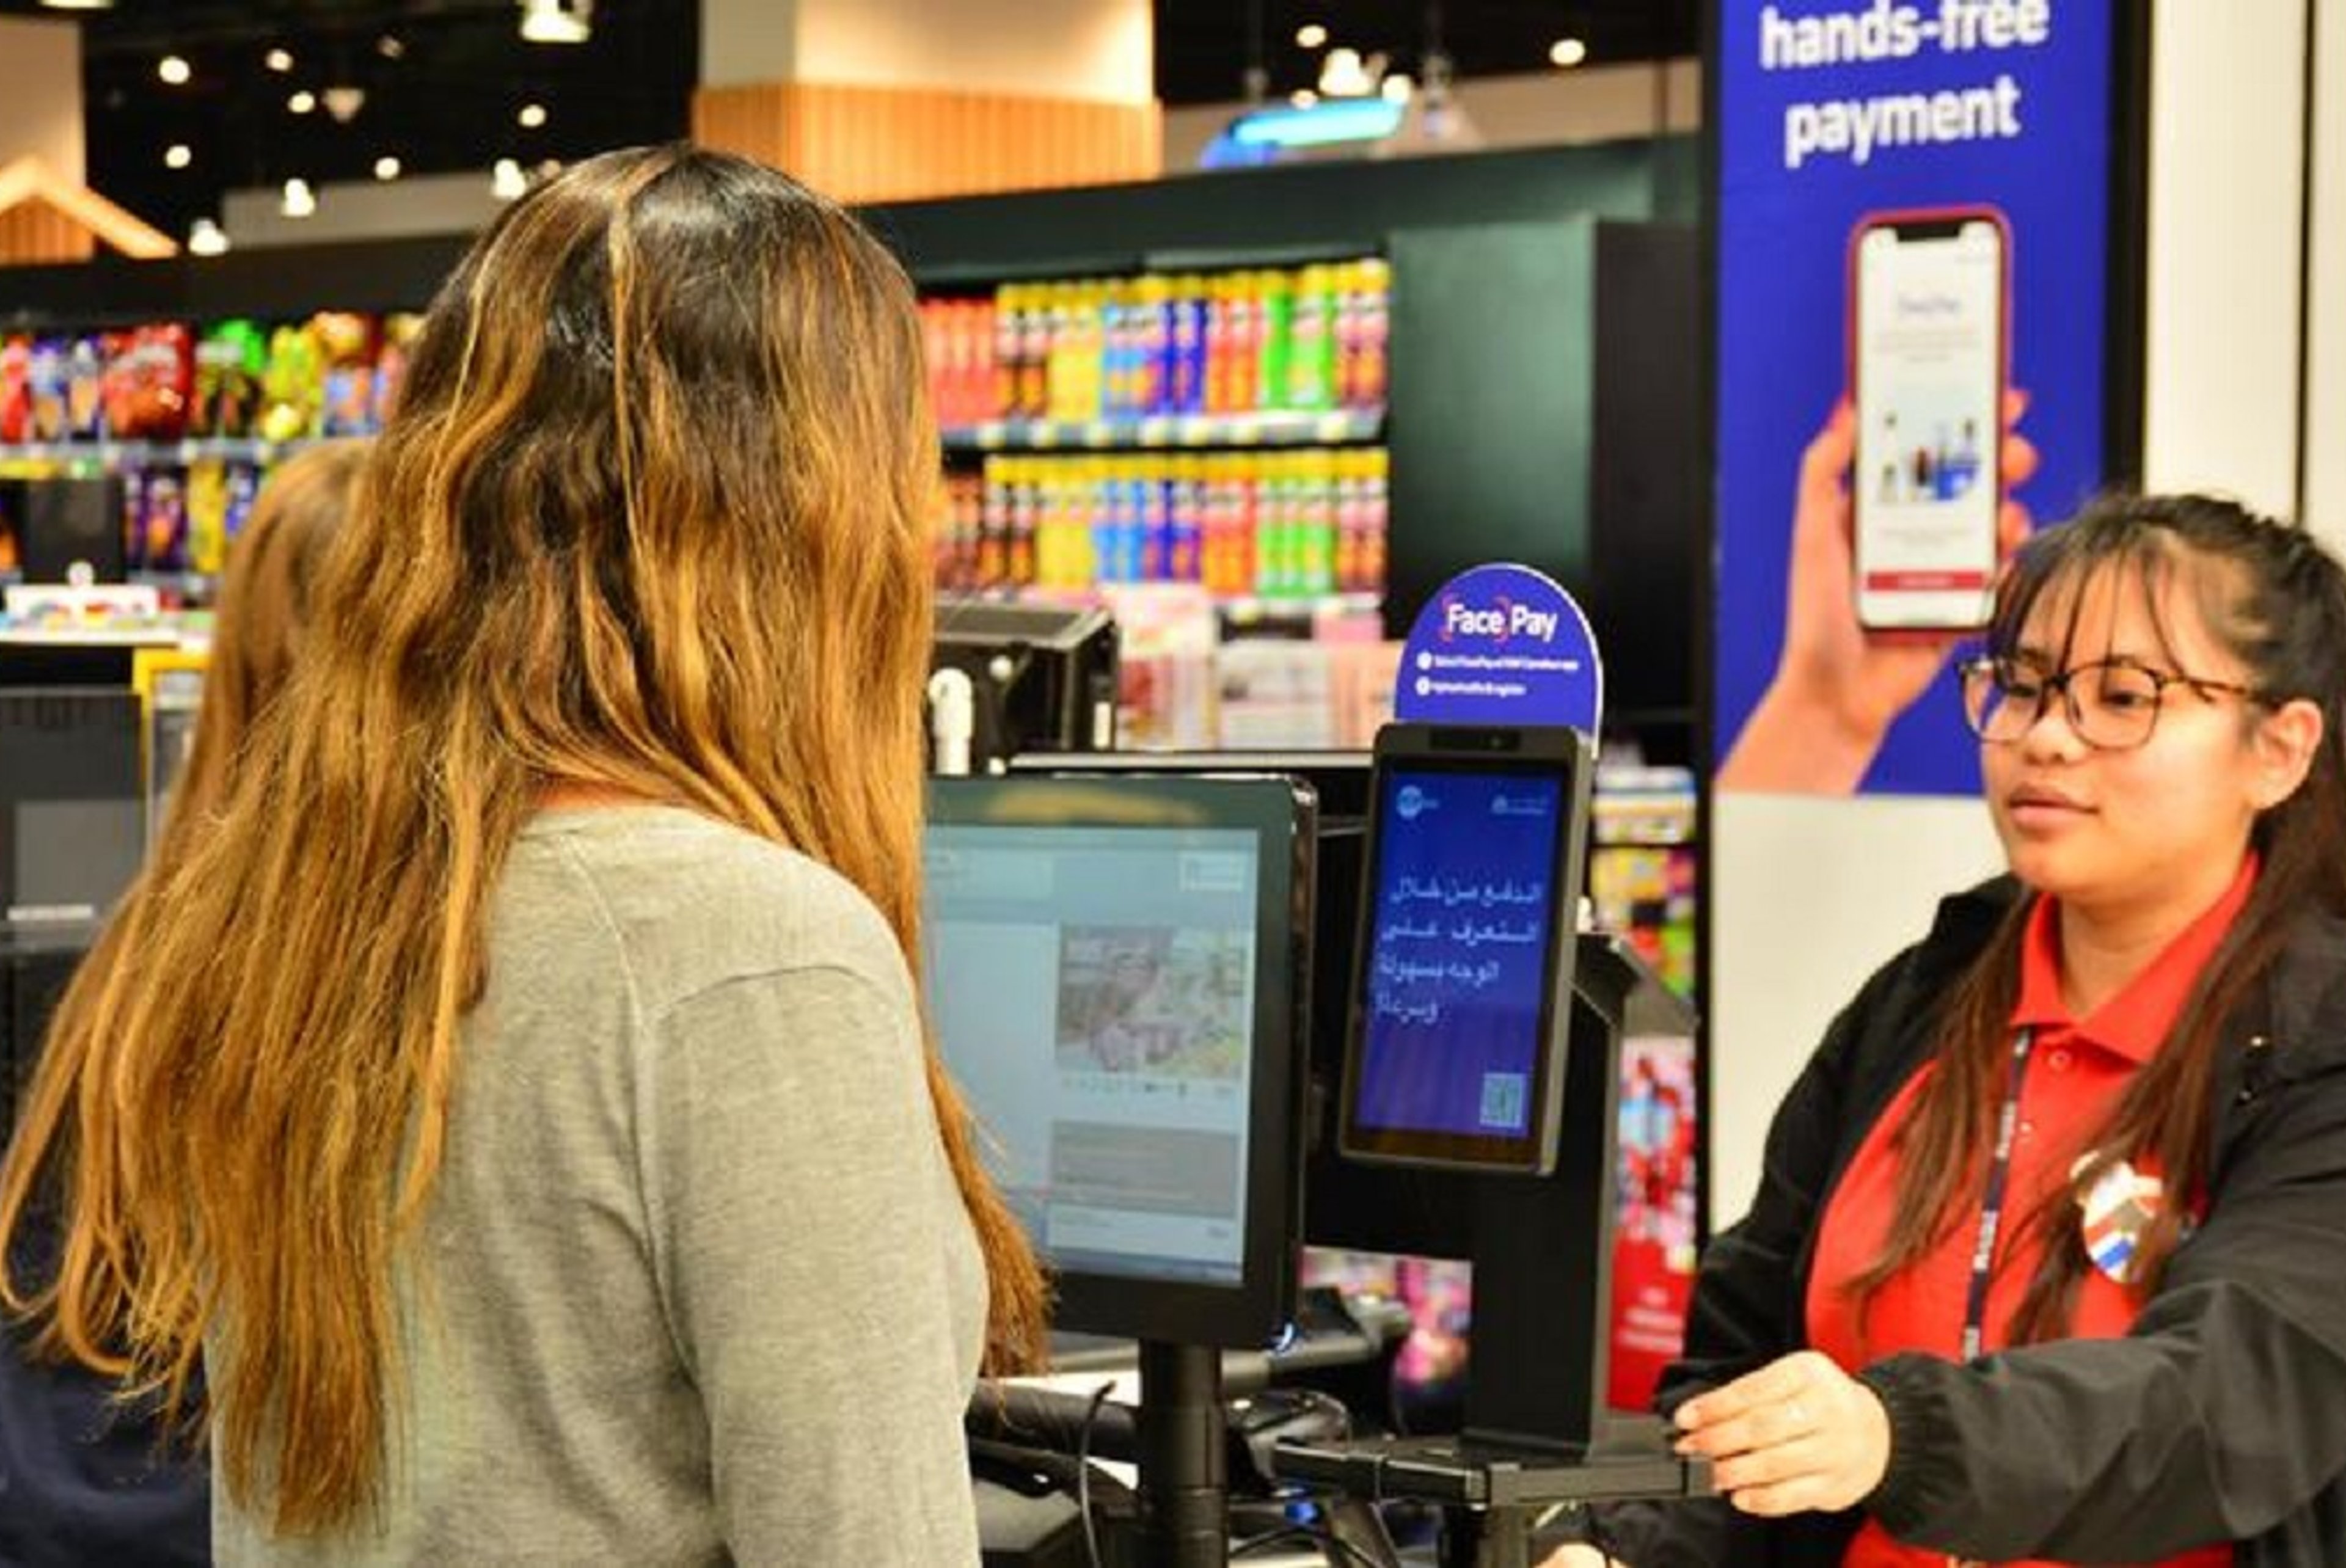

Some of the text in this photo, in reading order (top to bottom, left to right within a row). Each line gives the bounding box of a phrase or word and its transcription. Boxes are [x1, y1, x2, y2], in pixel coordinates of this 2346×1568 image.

[1760, 0, 2050, 70] hands-free
[1784, 75, 2021, 169] payment
[1447, 602, 1558, 643] Face Pay
